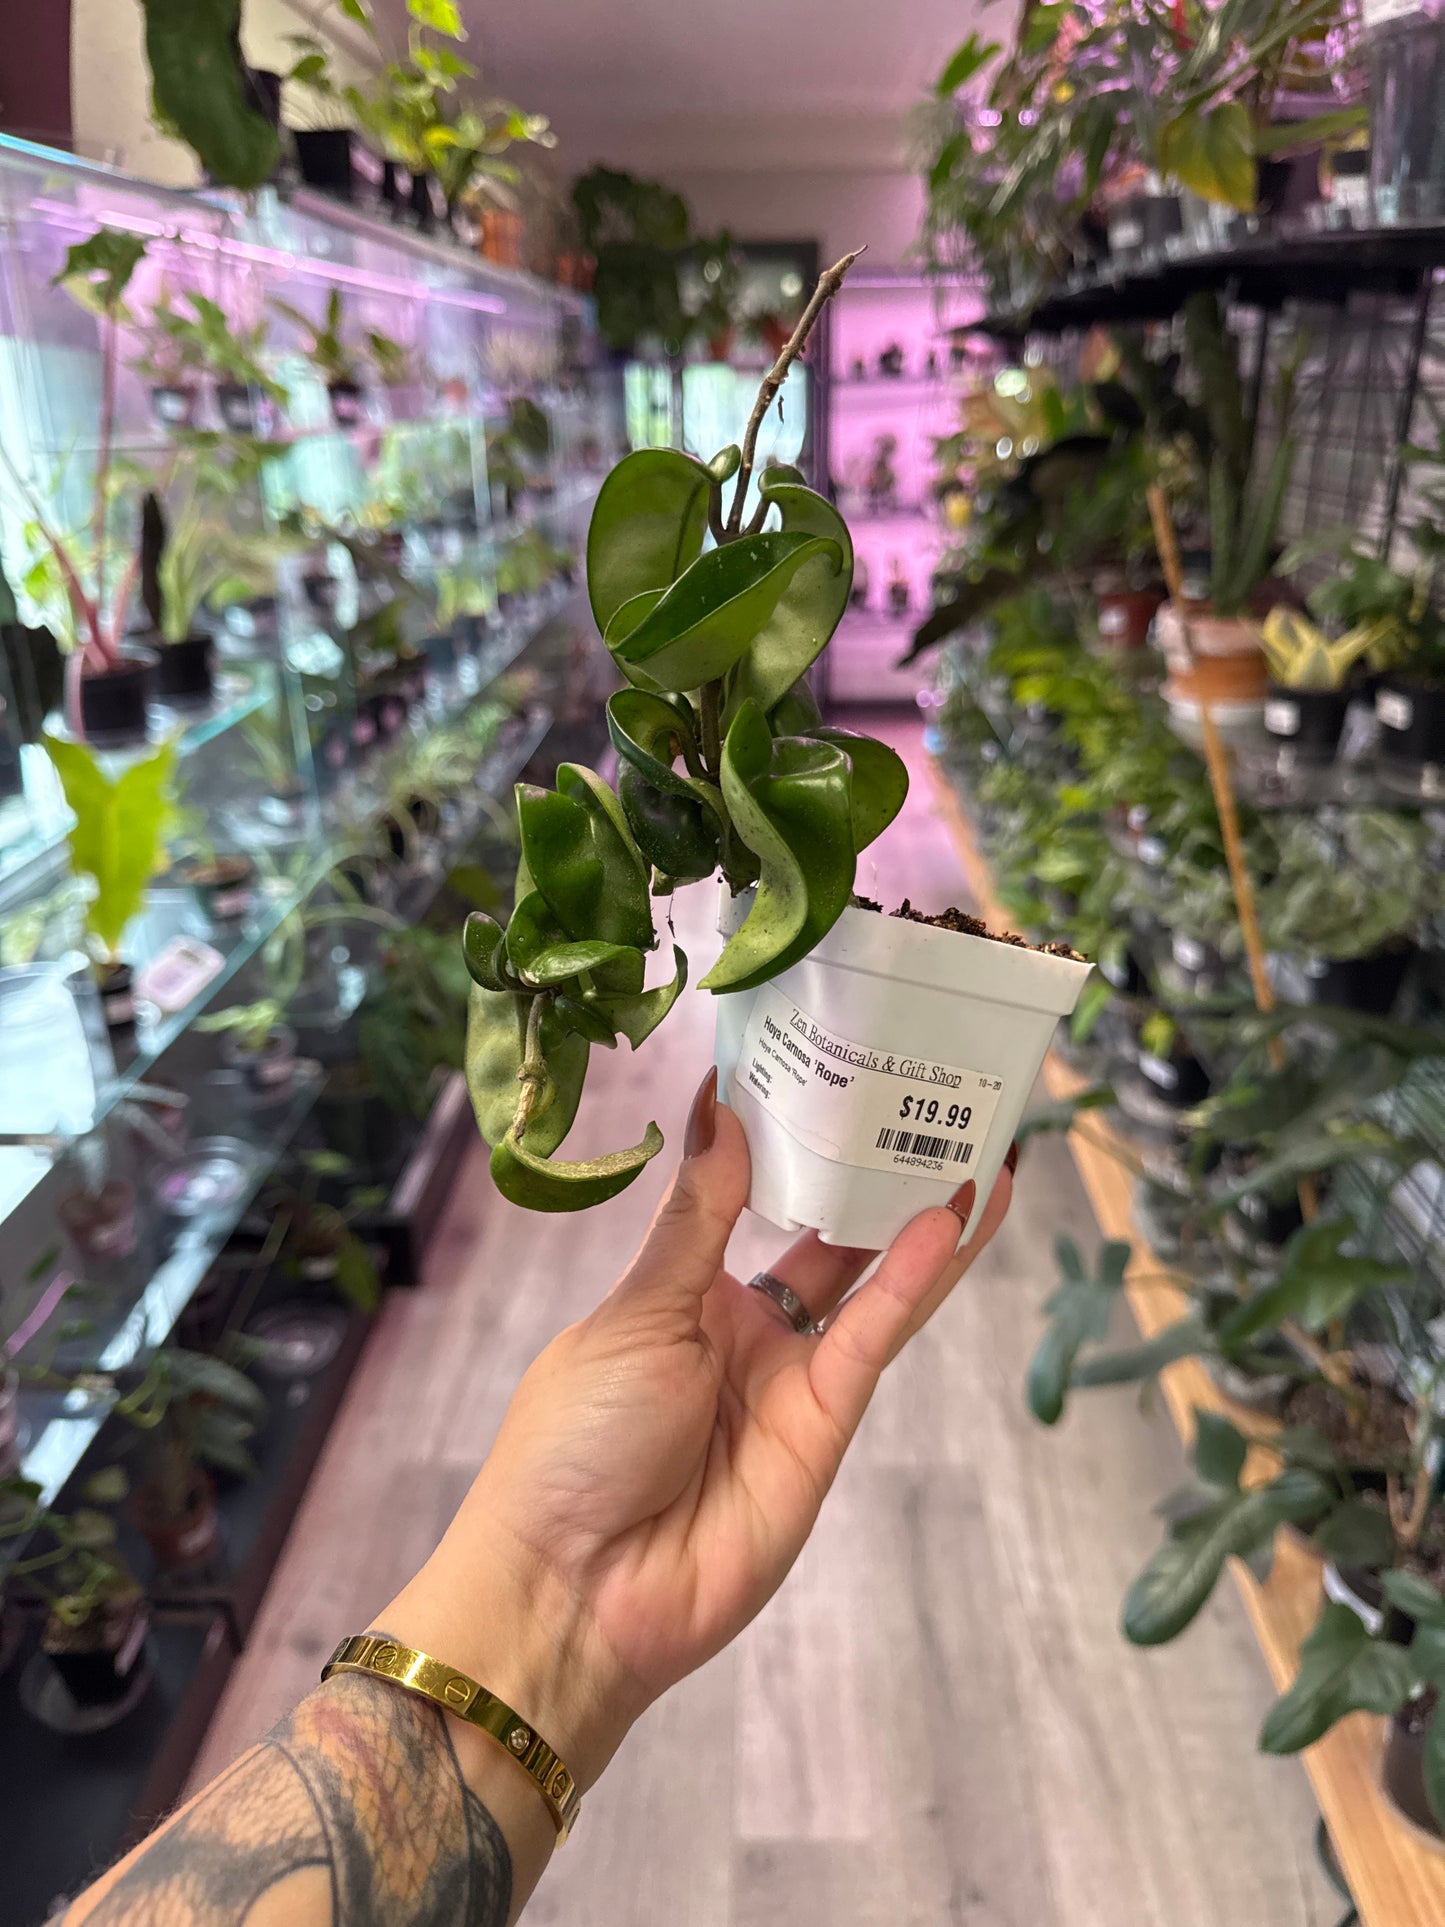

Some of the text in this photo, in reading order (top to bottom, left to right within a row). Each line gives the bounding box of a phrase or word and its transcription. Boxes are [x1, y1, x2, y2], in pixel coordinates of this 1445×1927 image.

[758, 1037, 772, 1053] Hoya
[763, 1015, 782, 1041] Hoya
[782, 1032, 811, 1068] Carnosa
[790, 1008, 962, 1087] Zen Botanicals & Gift Shop
[899, 1095, 972, 1130] $19.99
[892, 1154, 944, 1171] 644894236
